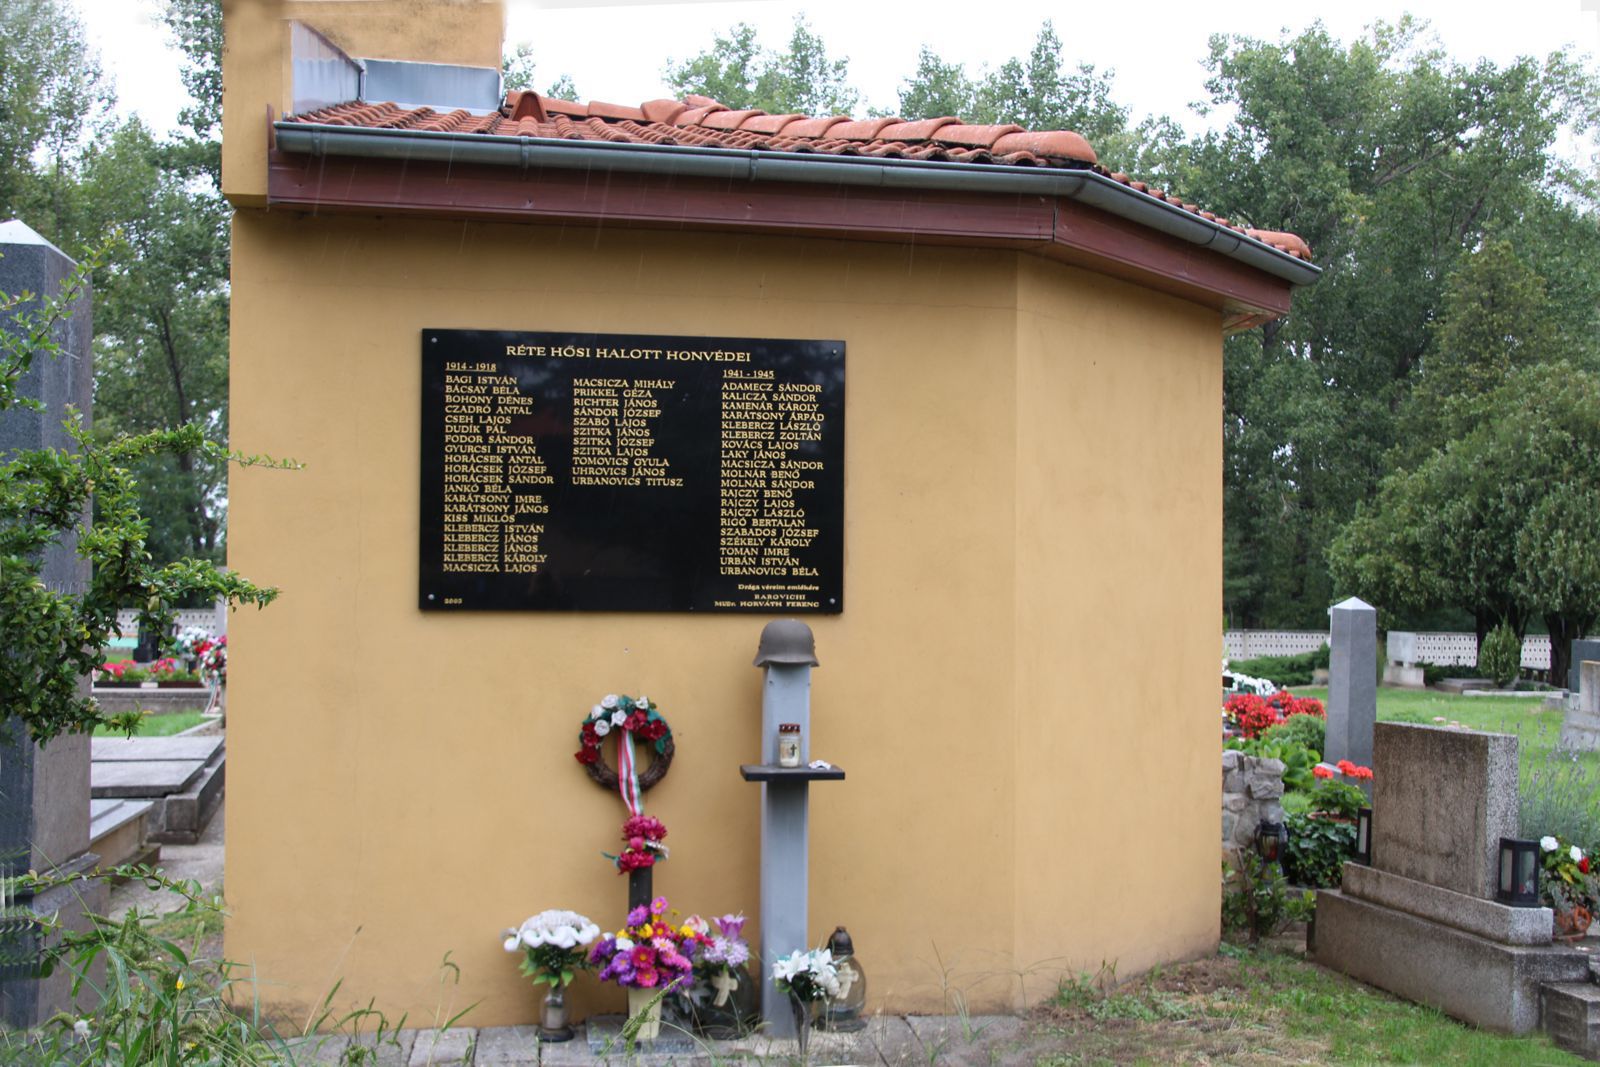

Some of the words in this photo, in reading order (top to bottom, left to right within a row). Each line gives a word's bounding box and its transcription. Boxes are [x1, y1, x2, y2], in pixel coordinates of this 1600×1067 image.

[506, 344, 546, 356] RÉTE
[551, 346, 590, 357] HŐSI
[596, 348, 662, 359] HALOTT
[667, 350, 751, 362] HONVÉDEI
[446, 362, 467, 372] 1914
[476, 363, 497, 372] 1918
[723, 370, 743, 378] 1941
[754, 370, 775, 379] 1945
[446, 375, 472, 384] BAGI
[478, 375, 517, 385] ISTVÁN
[573, 379, 629, 387] MACSICZA
[634, 379, 675, 389] MIHÁLY
[446, 385, 487, 394] BÁCSAY
[493, 385, 520, 395] BÉLA
[722, 383, 773, 391] ADAMECZ
[778, 382, 822, 392] SÁNDOR
[623, 388, 652, 398] GÉZA
[773, 393, 816, 402] SÁNDOR
[445, 395, 492, 404] BOHONY
[498, 396, 533, 405] DÉNES
[573, 398, 619, 407] RICHTER
[624, 398, 657, 408] JÁNOS
[445, 405, 491, 414] CZADRÓ
[496, 406, 532, 414] ANTAL
[722, 402, 773, 410] KAMENÁR
[778, 402, 819, 411] KÁROLY
[573, 408, 618, 416] SÁNDOR
[624, 408, 662, 417] JÓZSEF
[722, 412, 784, 420] KARÁTSONY
[790, 412, 824, 421] ÁRPÁD
[445, 416, 474, 424] CSEH
[479, 416, 511, 426] LAJOS
[573, 418, 609, 426] SZABÓ
[615, 419, 646, 428] LAJOS
[722, 422, 774, 430] KLEBERCZ
[780, 421, 820, 431] LÁSZLÓ
[486, 425, 507, 434] PÁL
[573, 428, 611, 436] SZITKA
[617, 428, 650, 437] JÁNOS
[445, 435, 483, 444] FODOR
[488, 434, 533, 445] SÁNDOR
[722, 431, 774, 439] KLEBERCZ
[780, 432, 822, 440] ZOLTÁN
[573, 438, 611, 446] SZITKA
[617, 437, 655, 447] JÓZSEF
[722, 440, 762, 448] KOVÁCS
[768, 442, 799, 450] LAJOS
[445, 445, 491, 454] GYURCSI
[497, 444, 536, 454] ISTVÁN
[573, 448, 611, 456] SZITKA
[617, 448, 648, 458] LAJOS
[445, 454, 503, 464] HORÁCSEK
[508, 456, 544, 464] ANTAL
[754, 450, 786, 460] JÁNOS
[573, 458, 628, 466] TOMOVICS
[634, 458, 669, 467] GYULA
[721, 460, 774, 468] MACSICZA
[780, 460, 824, 470] SÁNDOR
[445, 464, 503, 474] HORÁCSEK
[508, 465, 547, 475] JÓZSEF
[573, 467, 627, 476] UHROVICS
[632, 467, 665, 477] JÁNOS
[721, 469, 766, 478] MOLNÁR
[771, 470, 800, 479] BENŐ
[444, 474, 503, 484] HORÁCSEK
[509, 474, 554, 484] SÁNDOR
[572, 477, 641, 486] URBANOVICS
[646, 478, 683, 487] TITUSZ
[721, 479, 766, 488] MOLNÁR
[772, 479, 815, 489] SÁNDOR
[444, 484, 479, 494] JANKÓ
[485, 484, 512, 494] BÉLA
[720, 489, 759, 498] RAJCZY
[764, 489, 792, 498] BENŐ
[444, 494, 510, 503] KARÁTSONY
[515, 495, 542, 503] IMRE
[720, 499, 759, 508] RAJCZY
[764, 500, 795, 508] LAJOS
[444, 504, 510, 513] KARÁTSONY
[515, 504, 549, 514] JÁNOS
[720, 509, 759, 518] RAJCZY
[764, 508, 804, 518] LÁSZLÓ
[444, 514, 468, 522] KISS
[474, 514, 515, 523] MIKLÓS
[720, 518, 746, 526] RIGÓ
[752, 519, 805, 527] BERTALAN
[444, 524, 499, 532] KLEBERCZ
[505, 524, 544, 533] ISTVÁN
[720, 528, 776, 536] SZABADOS
[782, 528, 819, 538] JÓZSEF
[444, 534, 499, 542] KLEBERCZ
[505, 534, 538, 543] JÁNOS
[720, 537, 765, 546] SZÉKELY
[770, 537, 811, 546] KÁROLY
[444, 544, 499, 552] KLEBERCZ
[504, 543, 538, 553] JÁNOS
[764, 548, 790, 556] IMRE
[444, 554, 499, 562] KLEBERCZ
[504, 553, 547, 563] KÁROLY
[720, 557, 756, 565] URBÁN
[762, 556, 799, 566] ISTVÁN
[443, 564, 499, 572] MACSICZA
[505, 564, 537, 573] LAJOS
[720, 567, 787, 575] URBANOVICS
[792, 567, 818, 576] BÉLA
